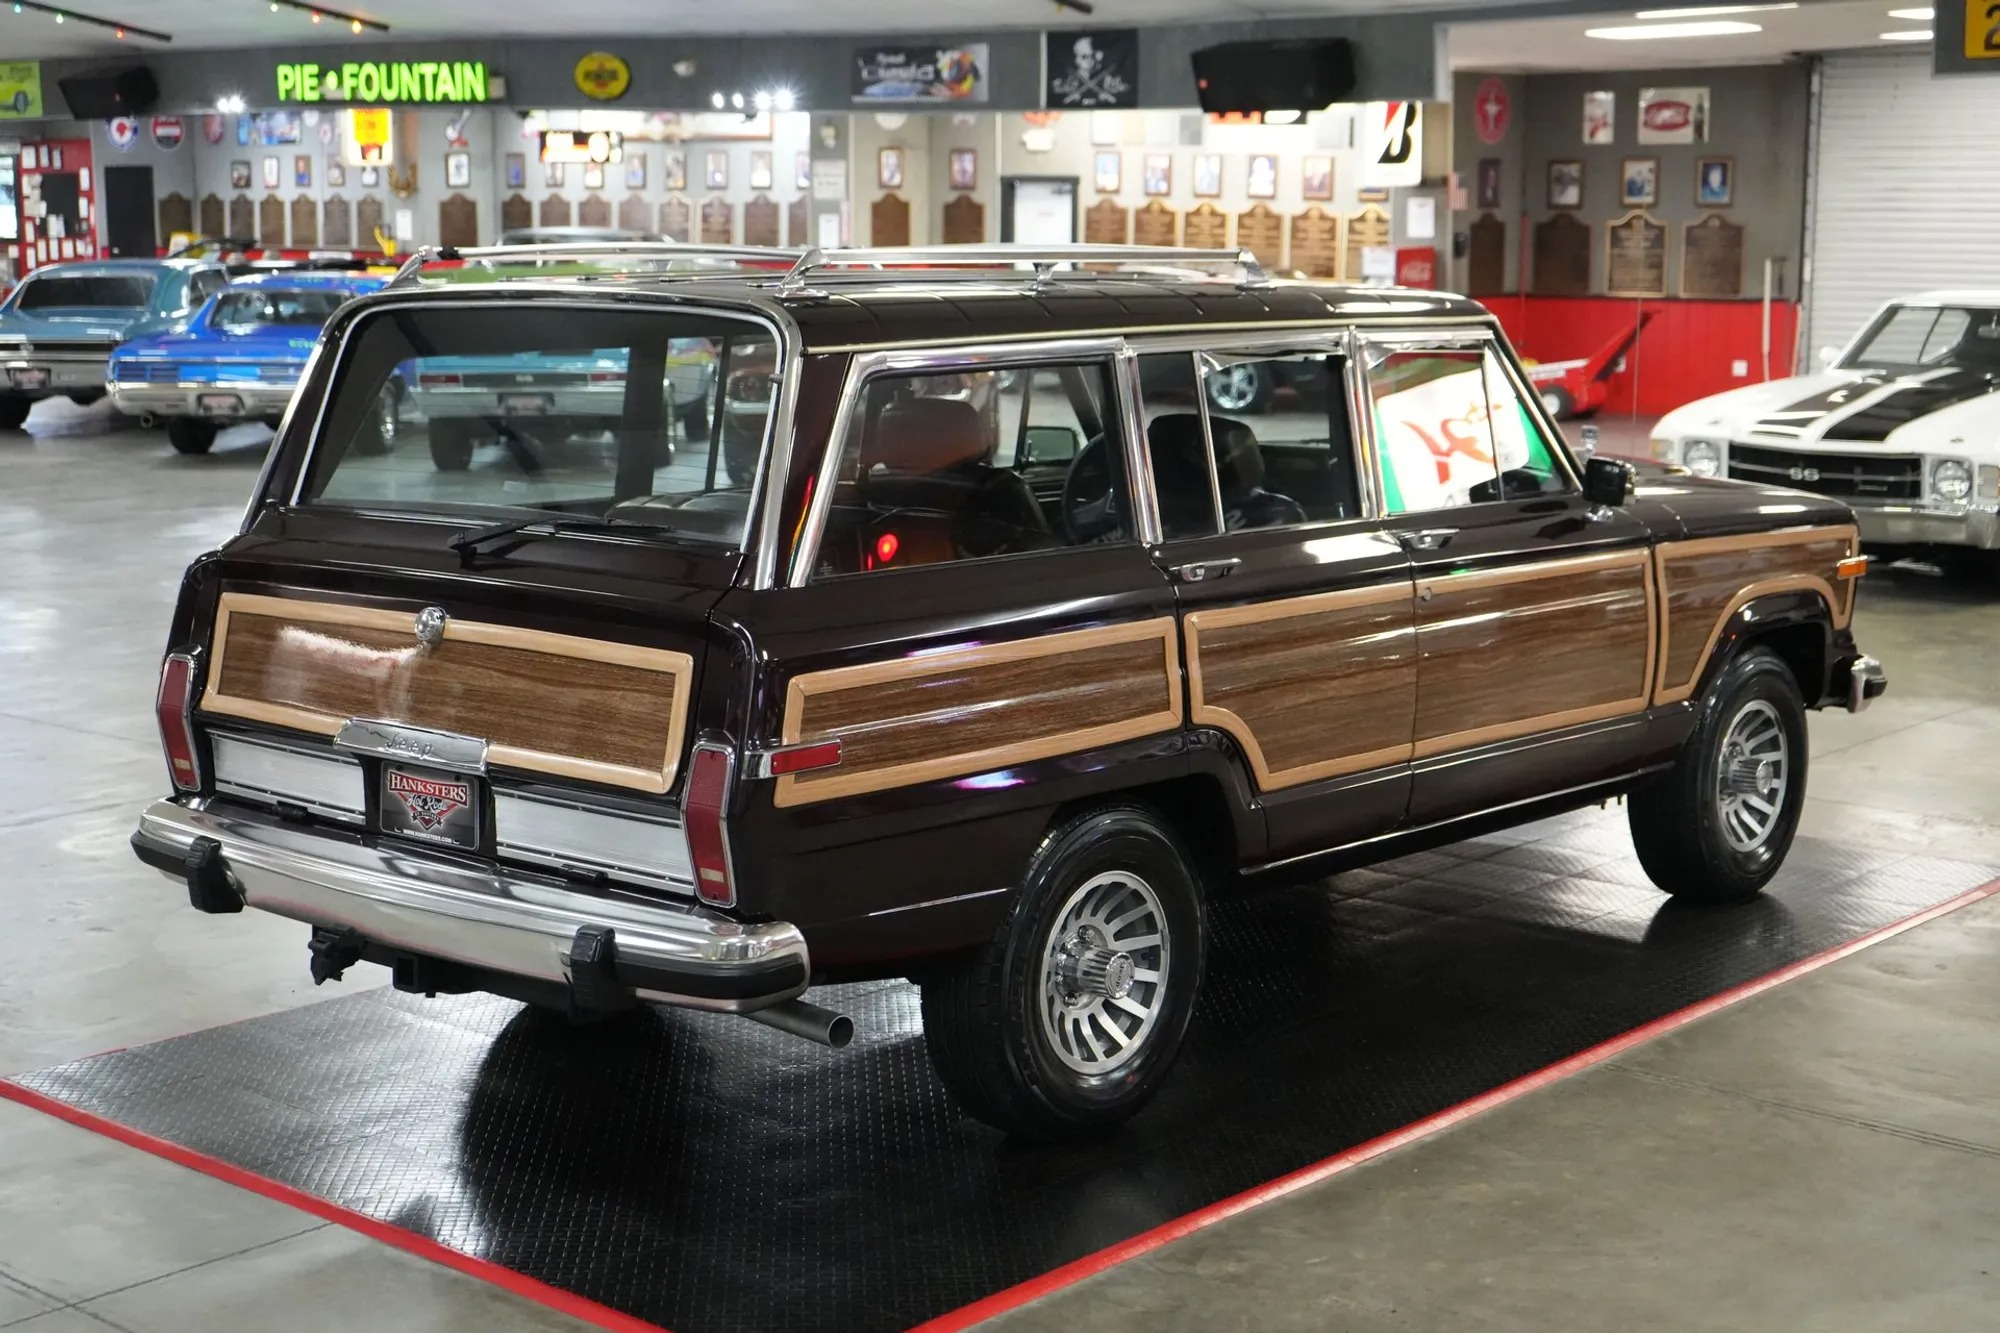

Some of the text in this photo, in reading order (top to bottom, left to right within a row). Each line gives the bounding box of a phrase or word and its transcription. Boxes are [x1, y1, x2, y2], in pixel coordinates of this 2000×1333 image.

[276, 62, 486, 102] PIE FOUNTAIN
[385, 732, 432, 759] Jeep
[390, 773, 466, 803] HANKSTERS
